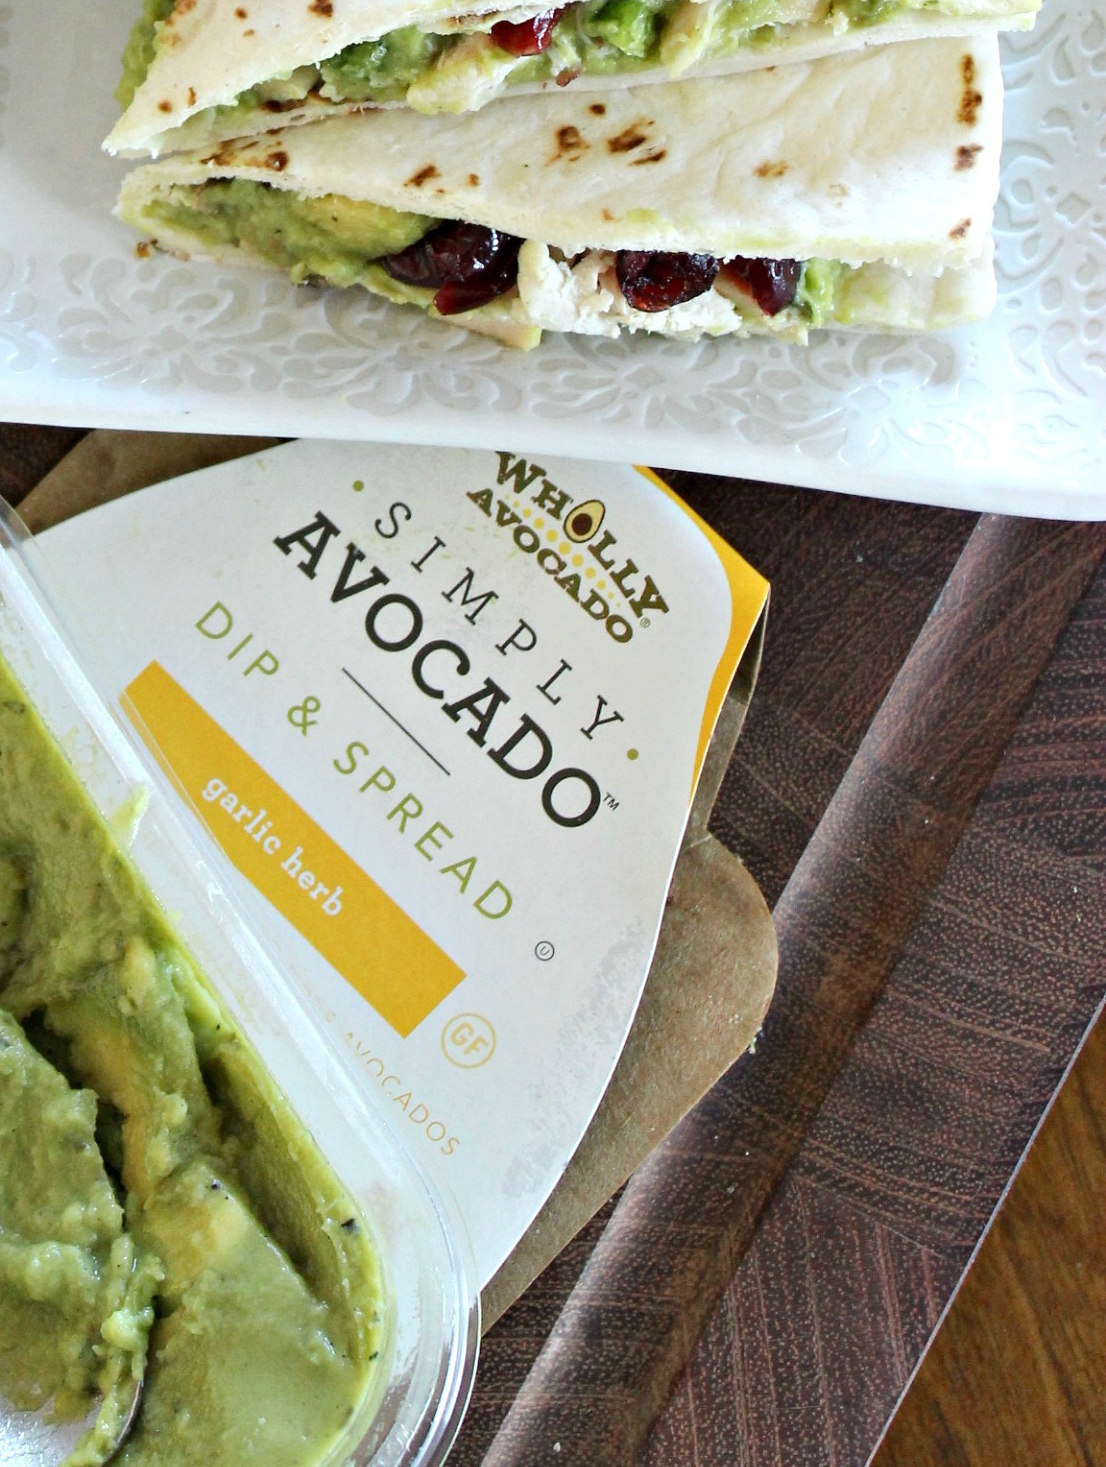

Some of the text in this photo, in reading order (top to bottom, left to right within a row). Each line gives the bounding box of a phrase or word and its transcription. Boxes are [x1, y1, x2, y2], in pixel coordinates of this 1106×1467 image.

[374, 502, 625, 740] SIMPLY
[465, 488, 634, 644] AVOCADO
[195, 601, 514, 921] DIP & SPREAD
[202, 776, 345, 918] garlic herb
